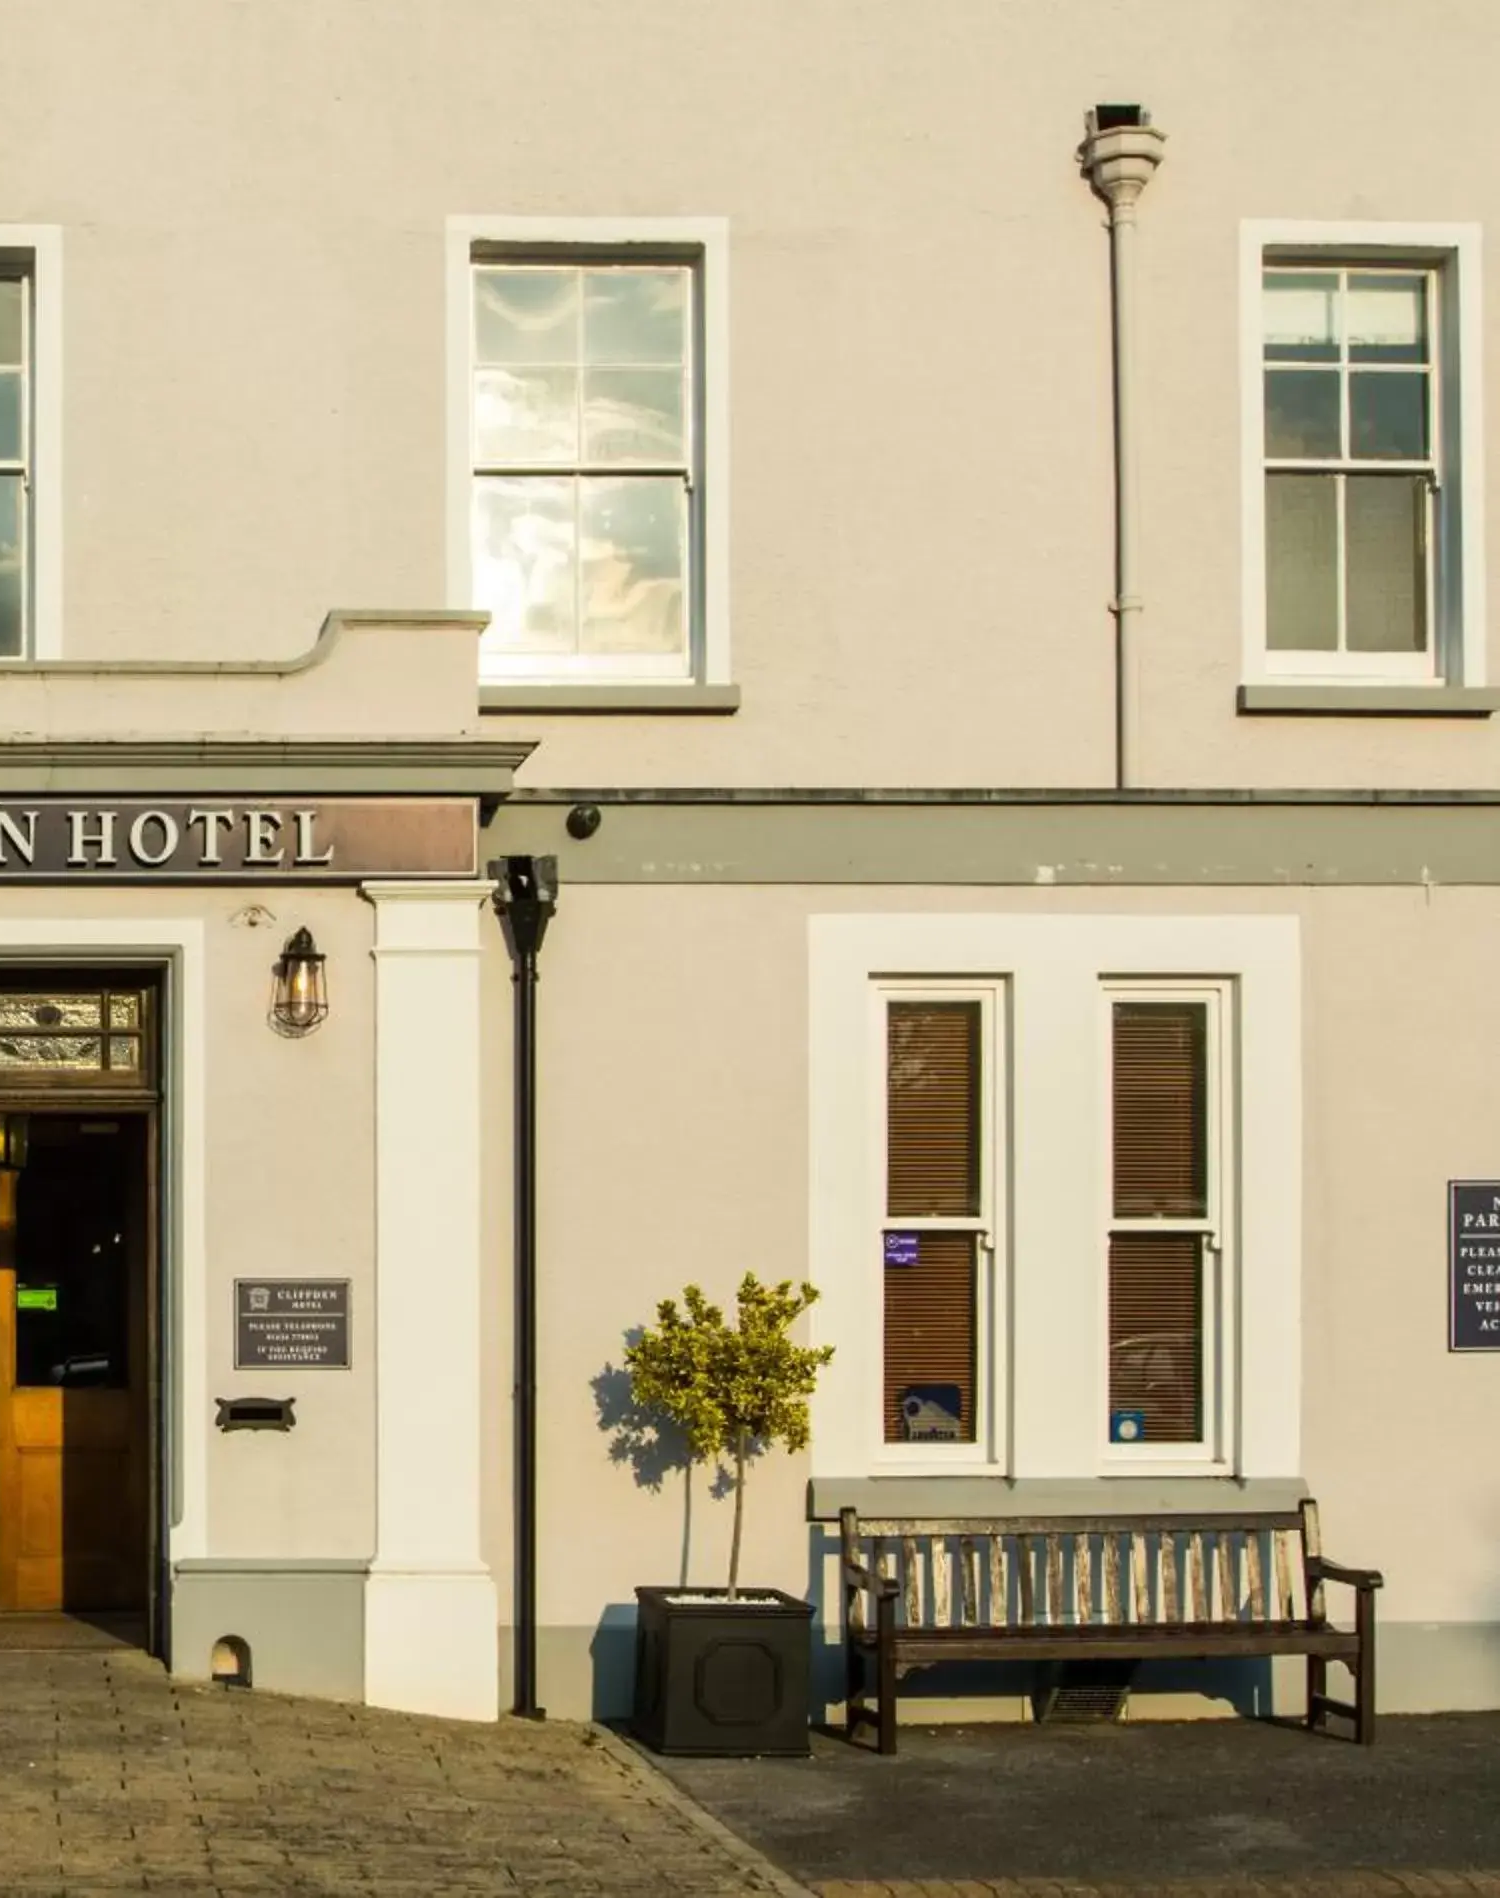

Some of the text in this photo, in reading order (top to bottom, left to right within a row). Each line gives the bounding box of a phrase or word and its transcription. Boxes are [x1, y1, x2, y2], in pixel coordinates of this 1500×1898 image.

[66, 808, 335, 864] HOTEL
[1460, 1247, 1500, 1258] PLEA
[277, 1290, 337, 1299] CLIFFDEN
[291, 1301, 322, 1309] HOTEL
